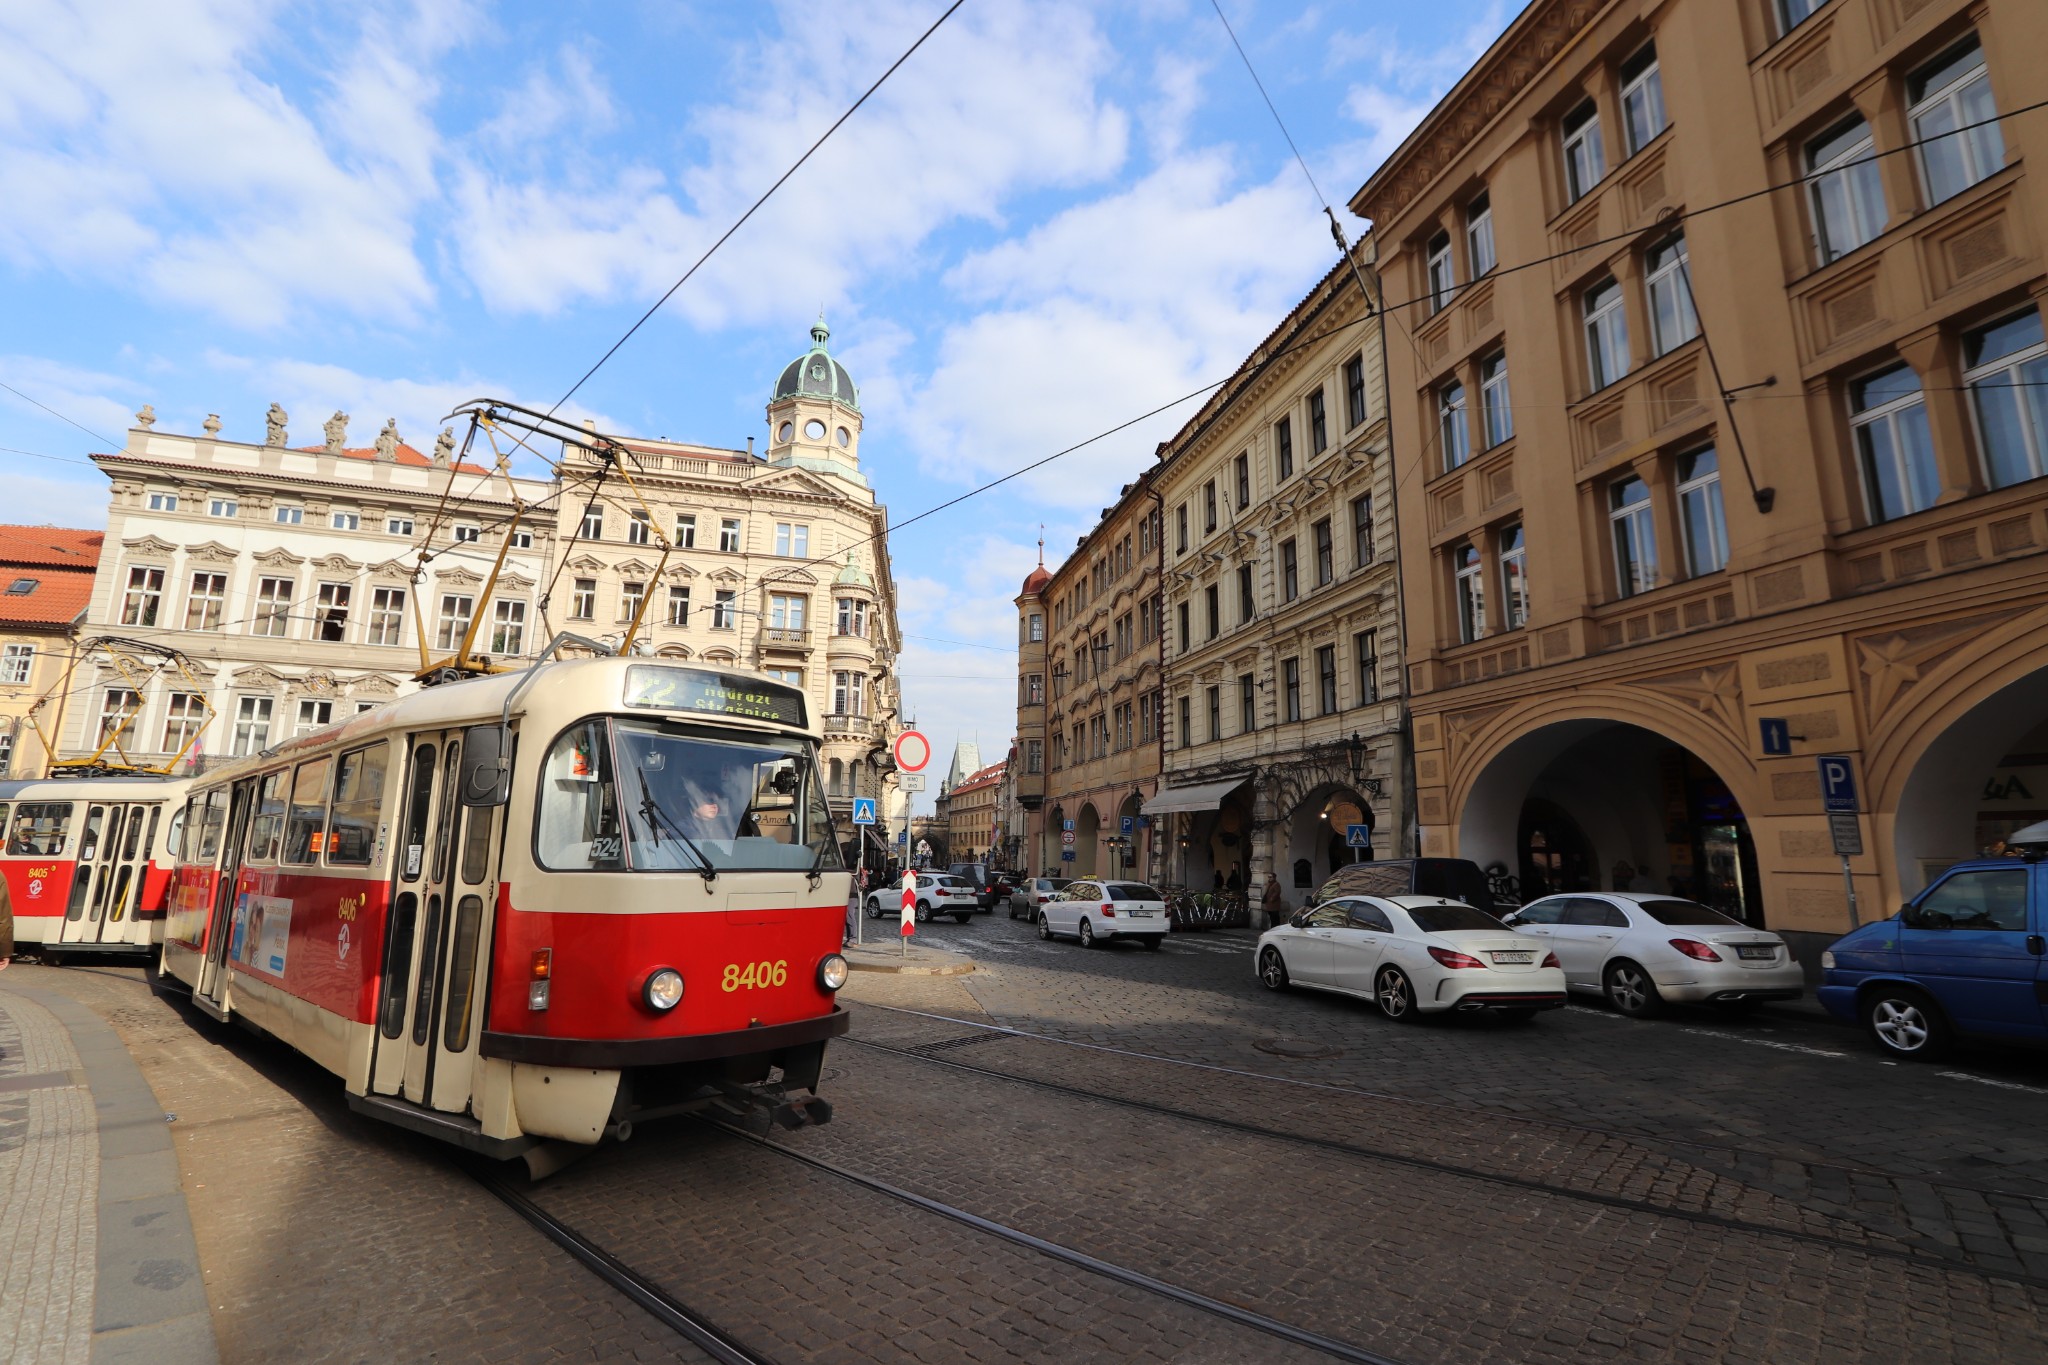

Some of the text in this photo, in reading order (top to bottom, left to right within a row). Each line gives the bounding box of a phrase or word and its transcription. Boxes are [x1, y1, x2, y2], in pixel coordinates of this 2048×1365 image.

[1826, 763, 1846, 795] P
[1123, 818, 1131, 830] P
[591, 838, 622, 857] 524
[28, 867, 49, 878] 8405
[339, 897, 357, 921] 8406
[721, 959, 788, 992] 8406
